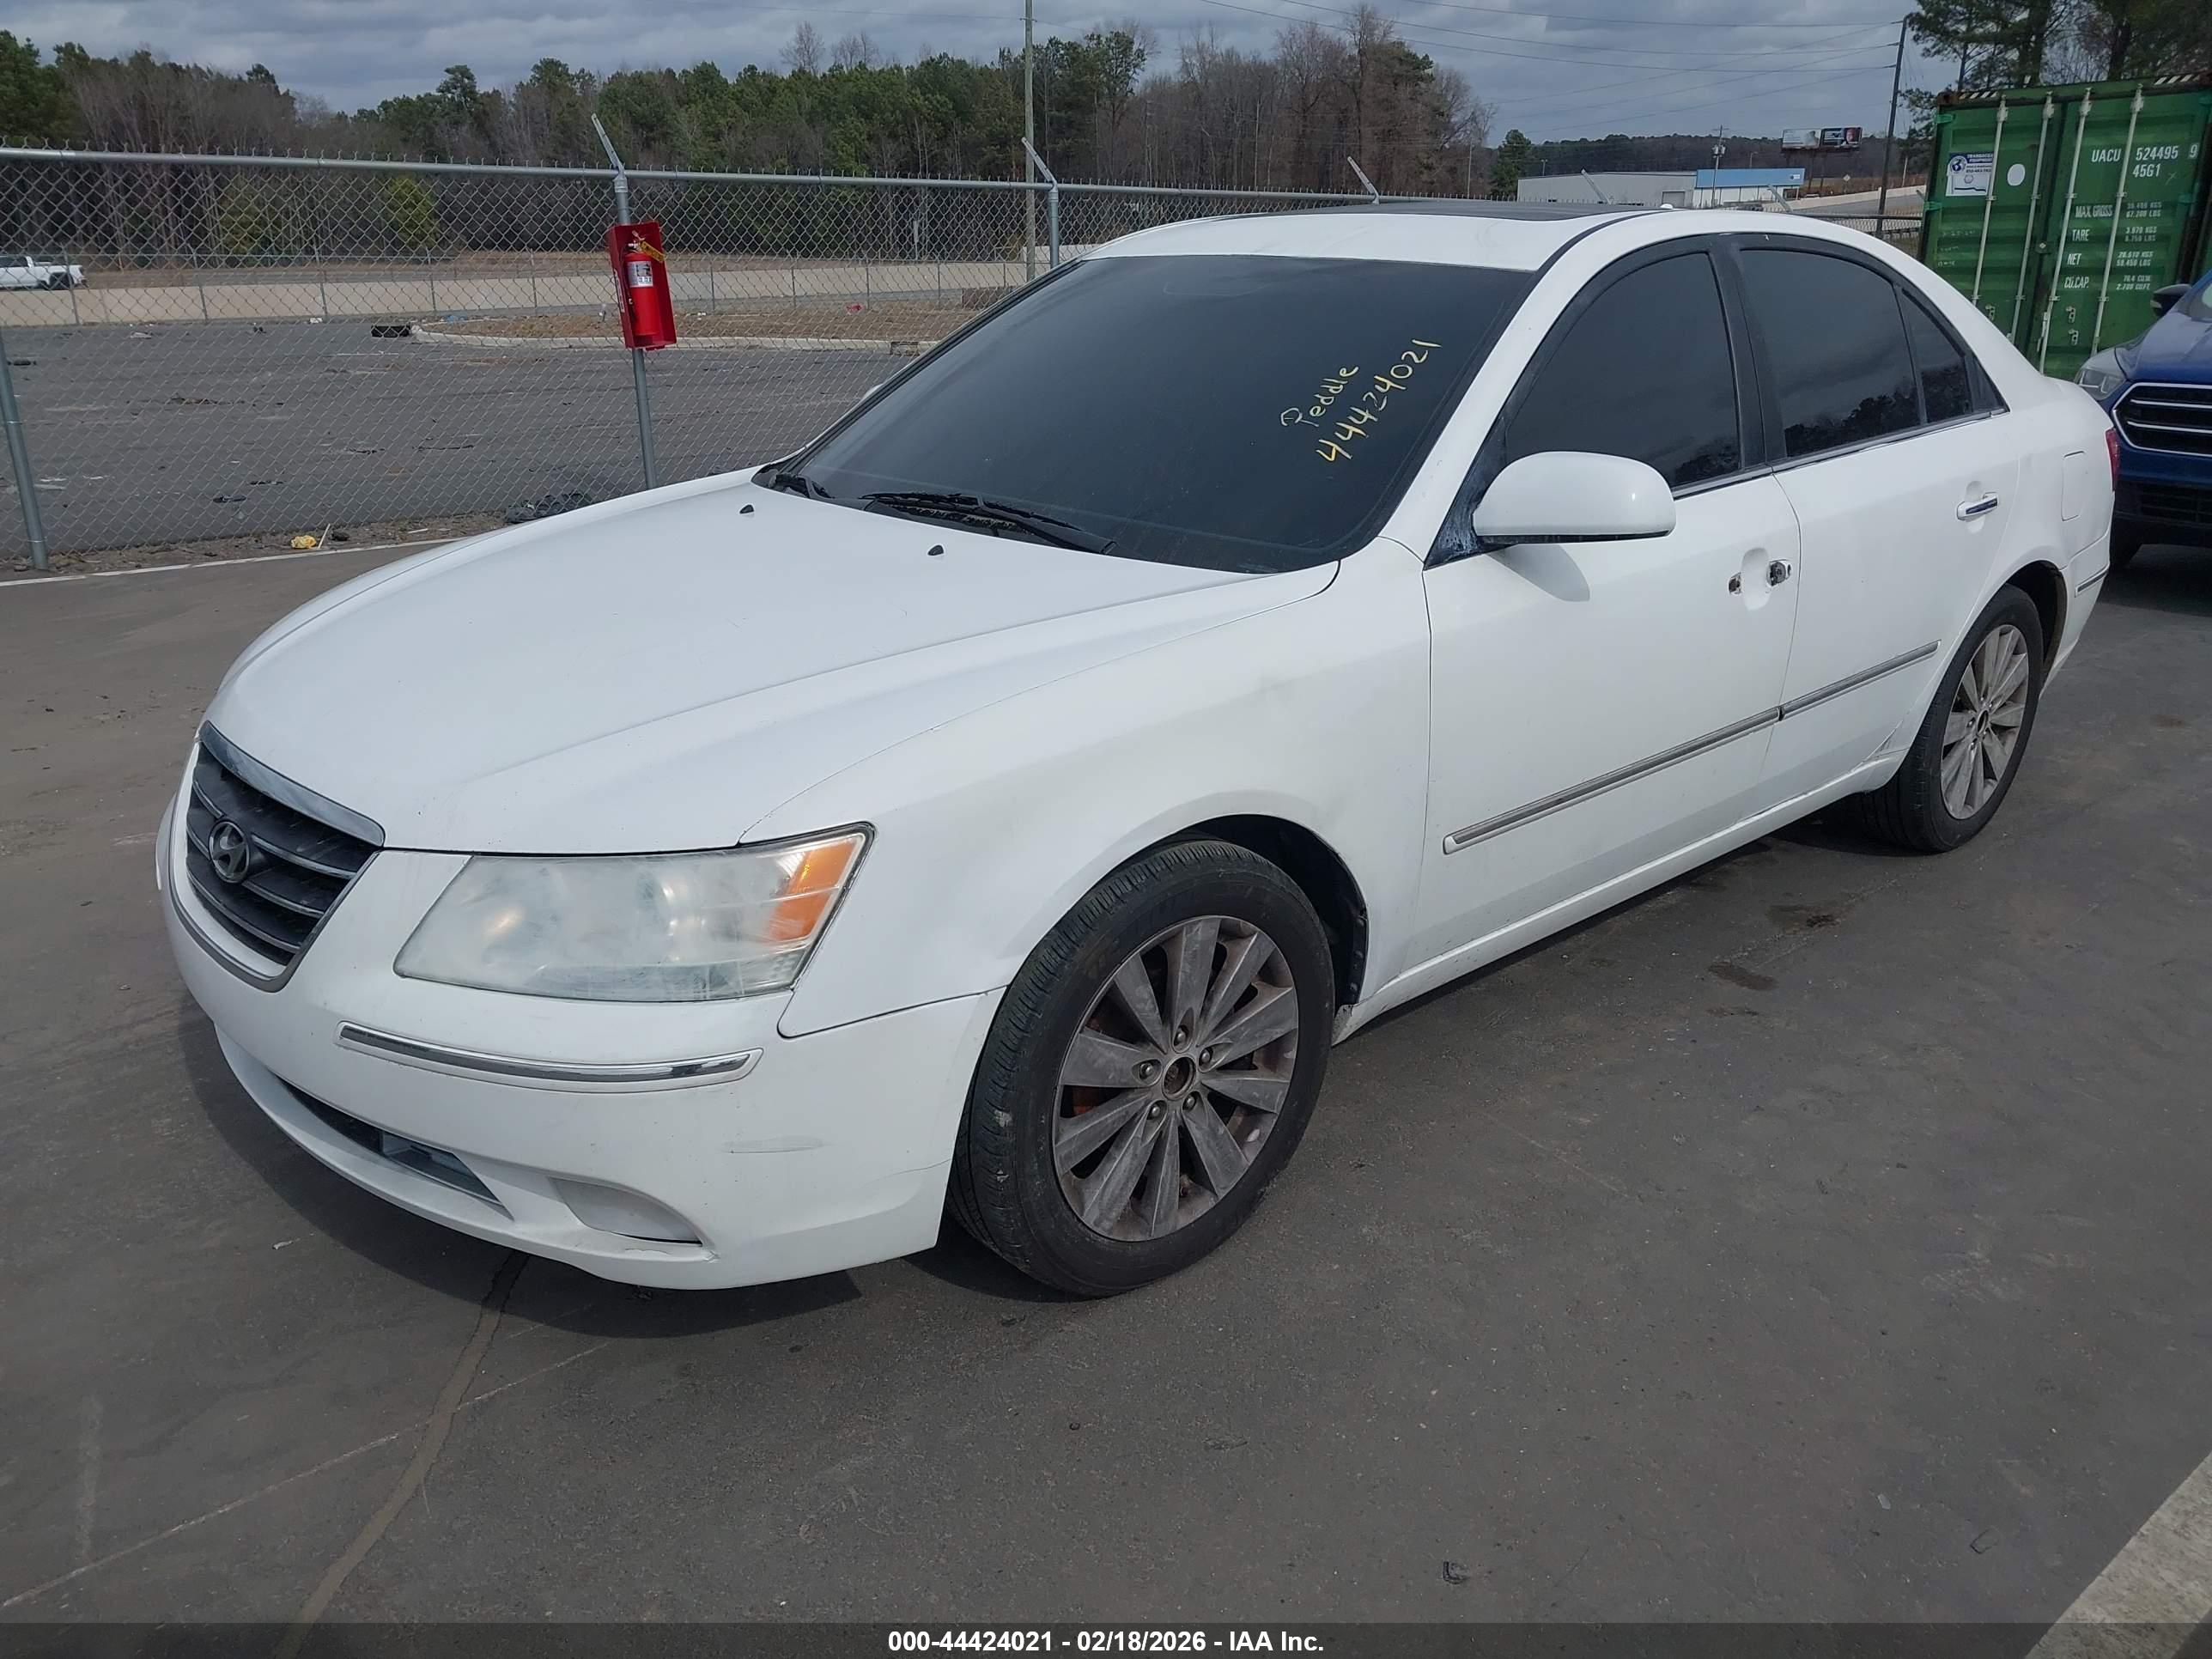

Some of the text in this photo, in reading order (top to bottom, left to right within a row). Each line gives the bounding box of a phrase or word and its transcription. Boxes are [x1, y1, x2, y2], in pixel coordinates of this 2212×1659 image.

[2091, 143, 2198, 162] UACU 524495 9
[2133, 163, 2161, 178] 45G1
[2075, 205, 2092, 218] MAX
[2093, 204, 2112, 217] GROSS
[2072, 228, 2090, 241] TARE
[2067, 252, 2082, 265] NET
[1315, 338, 1443, 461] 44424021
